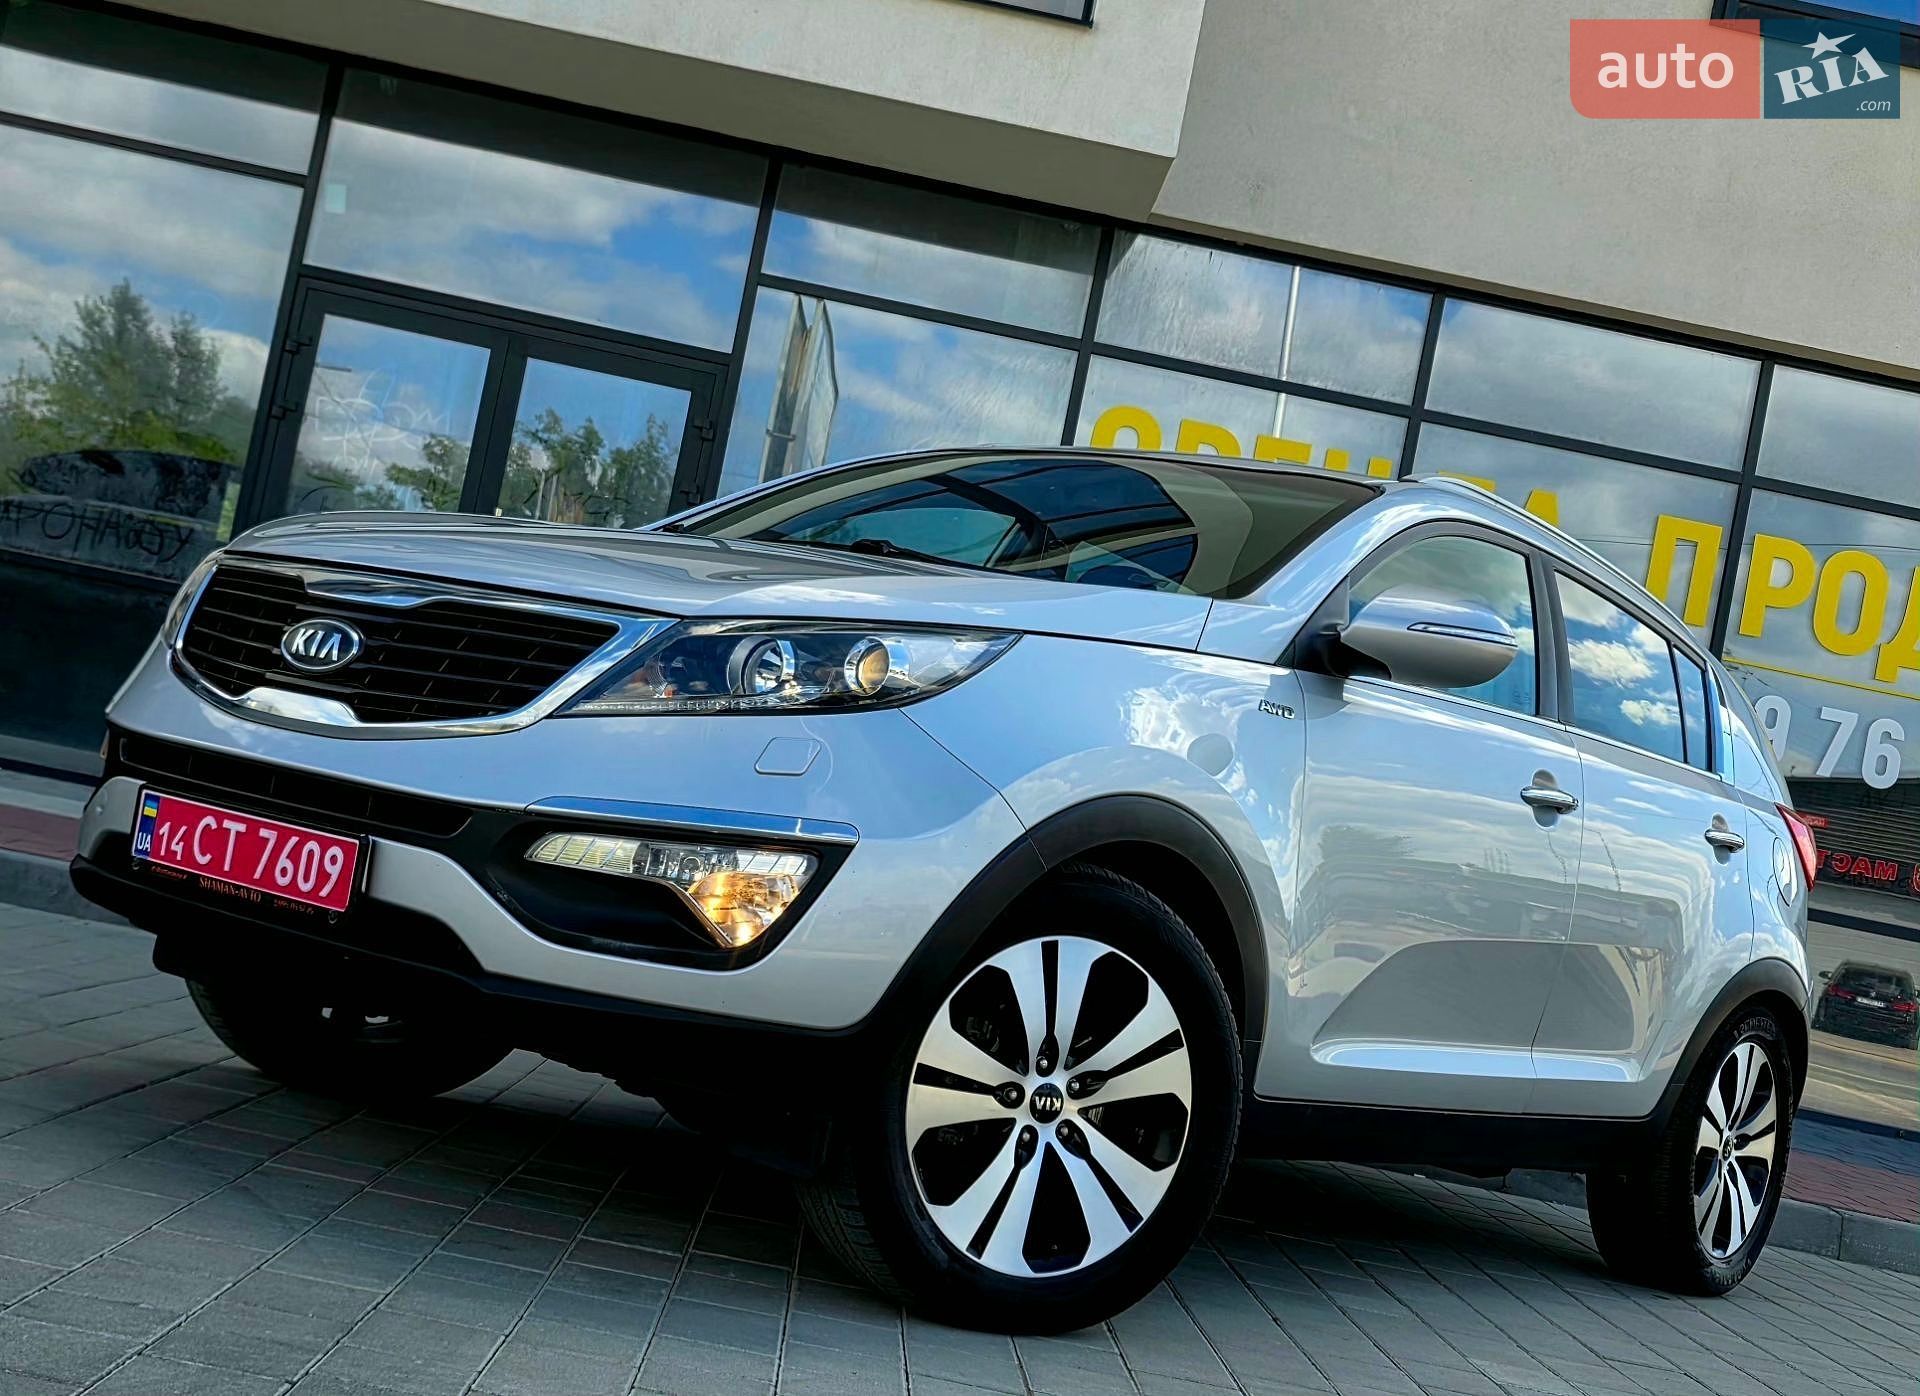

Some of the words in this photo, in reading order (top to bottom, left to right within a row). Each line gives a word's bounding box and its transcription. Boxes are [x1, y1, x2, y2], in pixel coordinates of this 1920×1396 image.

[291, 628, 342, 661] KIA
[1258, 699, 1295, 719] AWD
[1816, 706, 1905, 789] 76
[137, 831, 151, 851] UA
[253, 828, 344, 897] 7609
